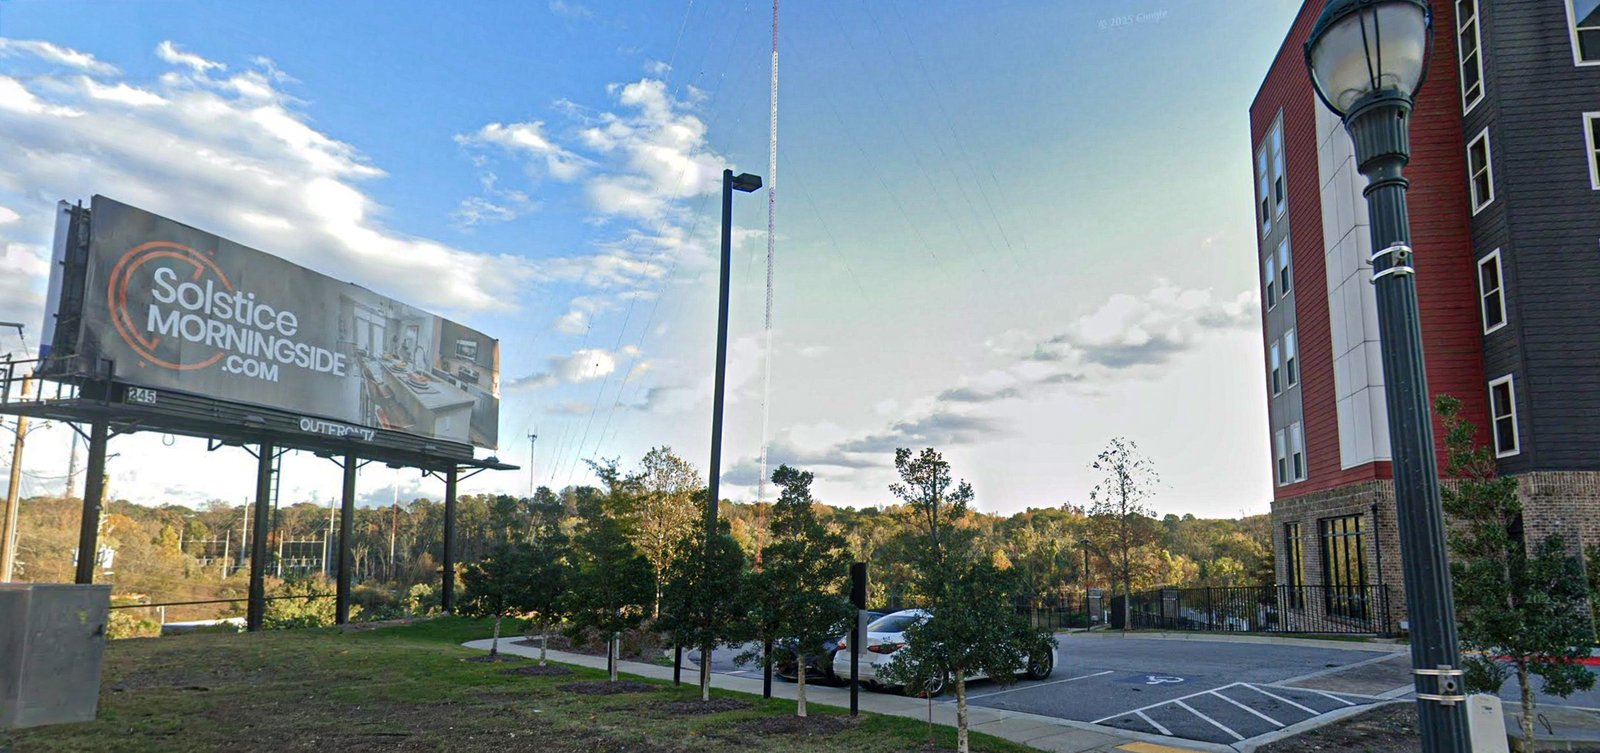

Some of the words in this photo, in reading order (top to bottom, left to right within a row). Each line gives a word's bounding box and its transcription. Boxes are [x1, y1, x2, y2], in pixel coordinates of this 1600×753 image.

[151, 267, 298, 337] Solstice
[147, 304, 346, 377] MORNINGSIDE
[221, 355, 279, 382] .COM
[129, 387, 155, 402] 245
